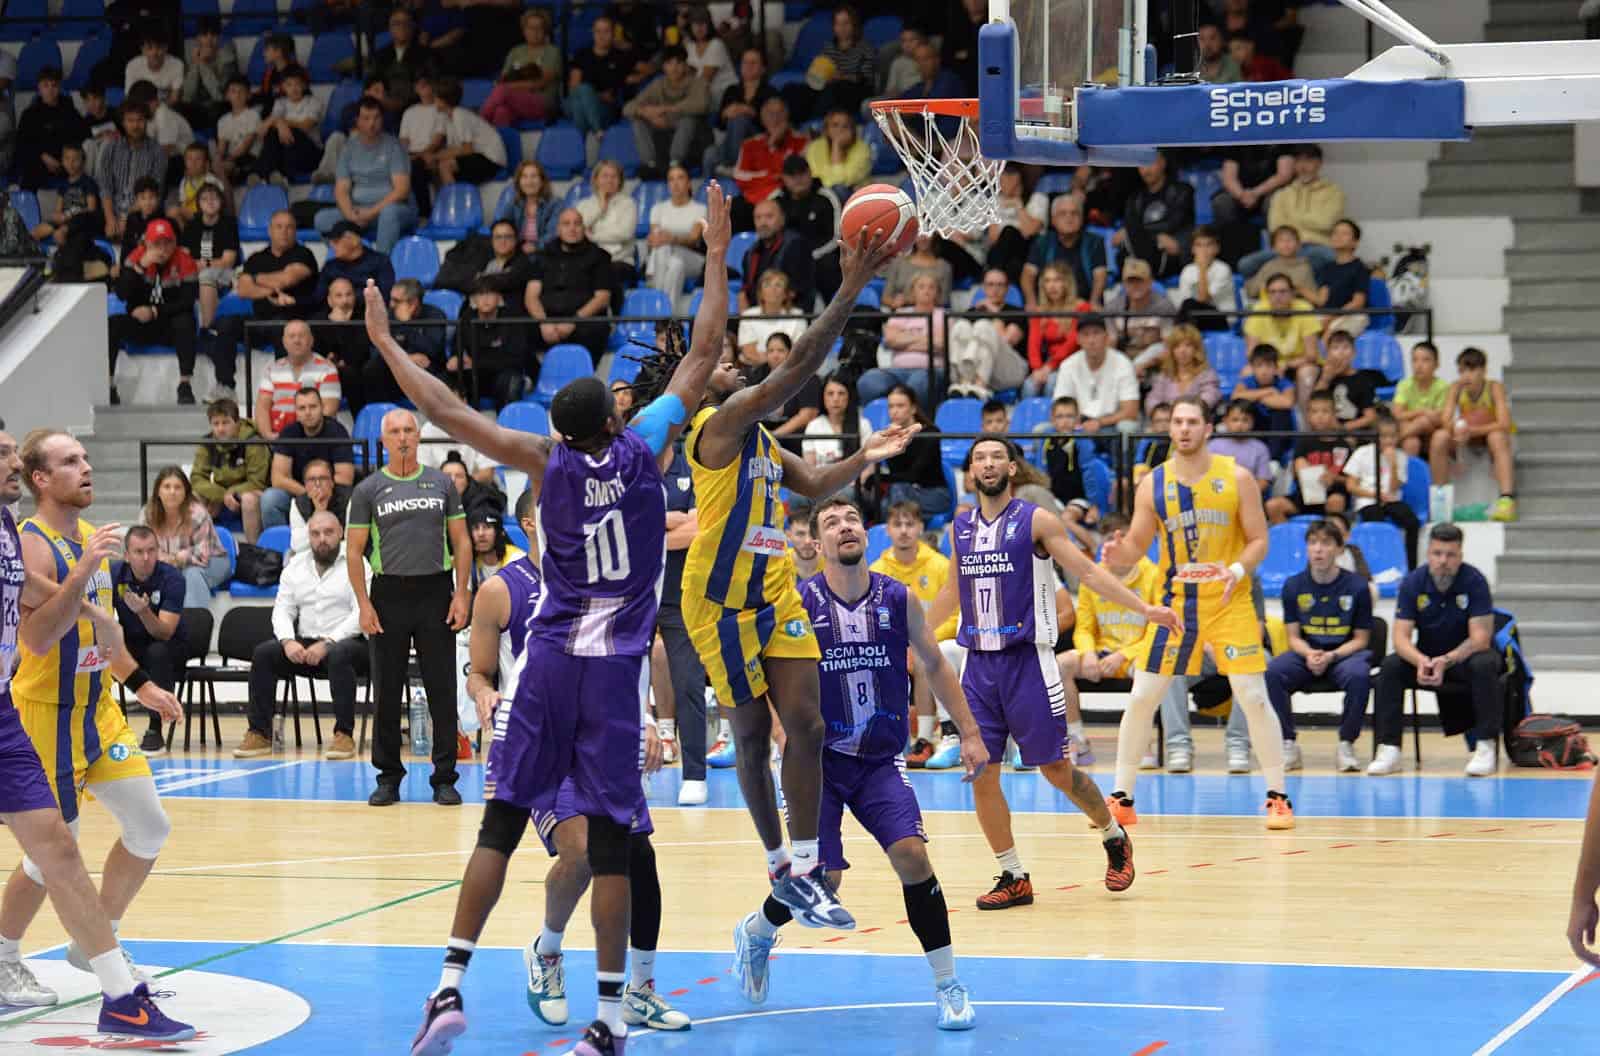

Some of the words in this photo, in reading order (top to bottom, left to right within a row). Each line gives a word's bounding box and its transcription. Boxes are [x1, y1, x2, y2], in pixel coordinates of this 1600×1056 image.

[1210, 85, 1326, 108] Schelde
[1210, 105, 1326, 131] Sports
[584, 471, 626, 508] SMITH
[377, 497, 445, 517] LINKSOFT
[583, 509, 631, 584] 10
[961, 555, 983, 565] SCM
[984, 552, 1009, 563] POLI
[979, 588, 992, 614] 17
[825, 646, 855, 660] SCM
[857, 681, 868, 706] 8
